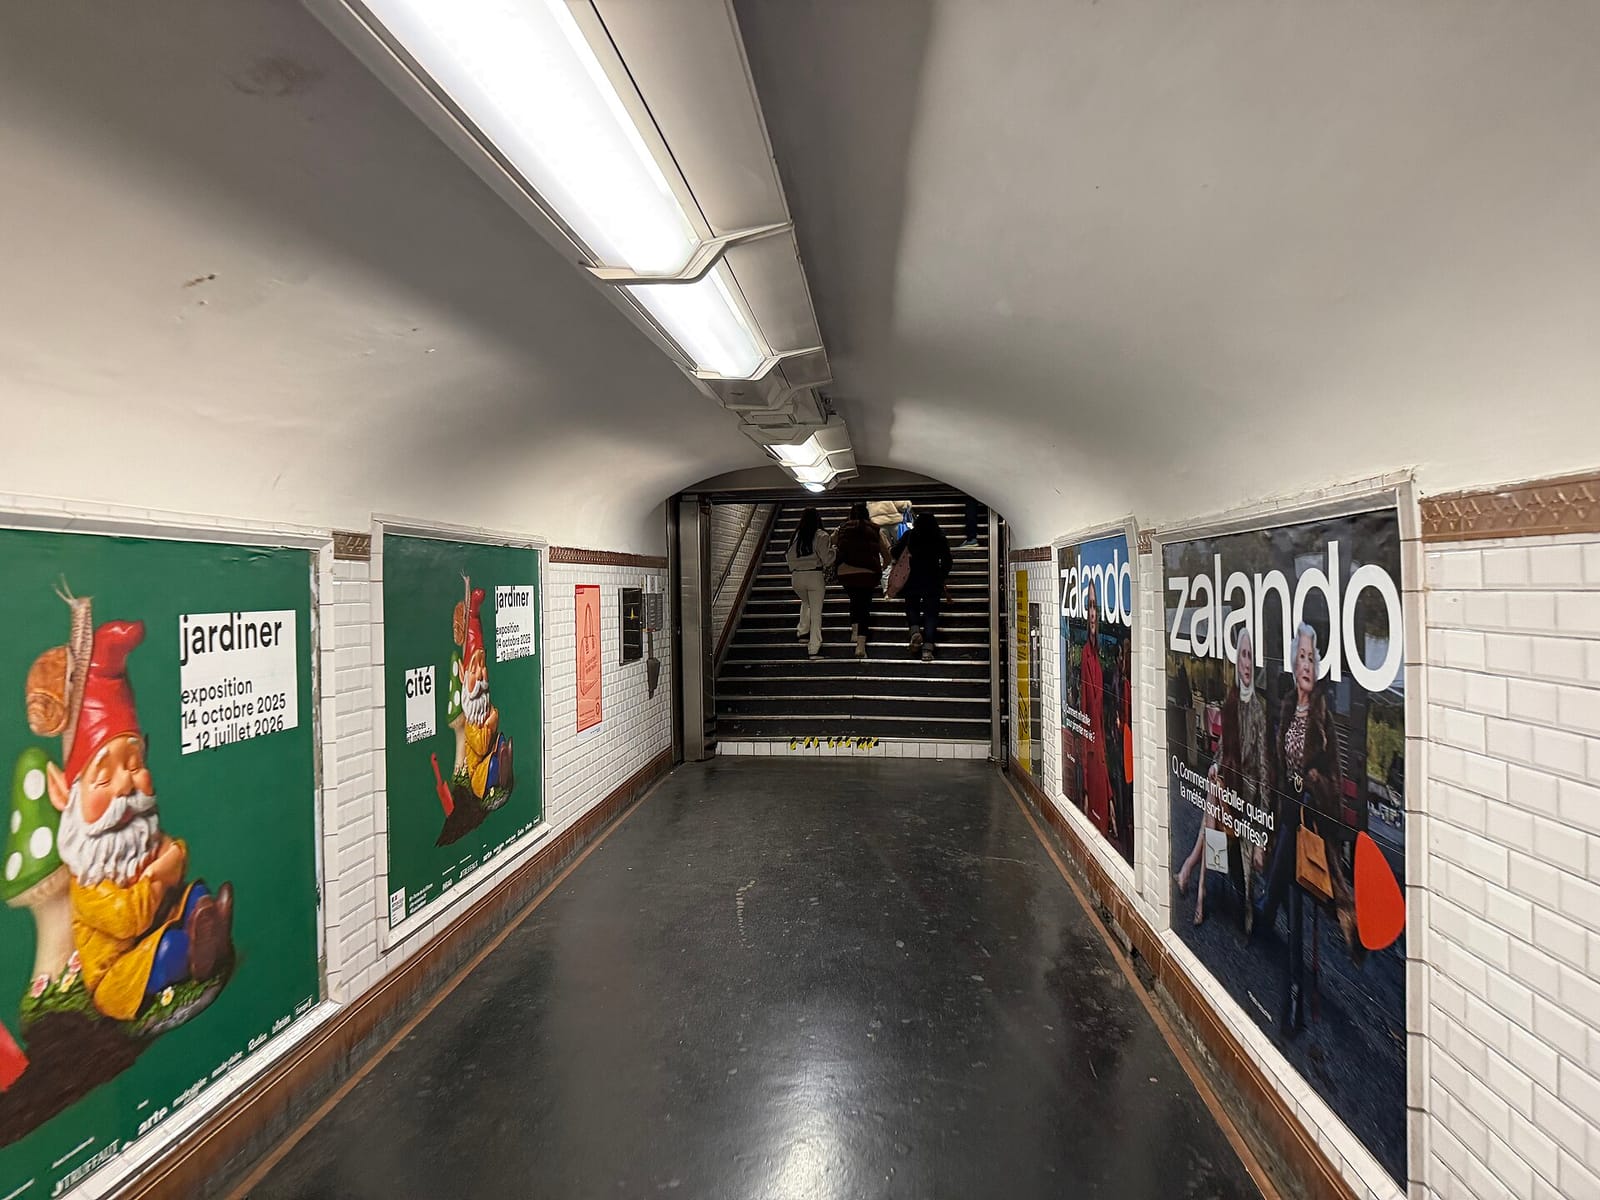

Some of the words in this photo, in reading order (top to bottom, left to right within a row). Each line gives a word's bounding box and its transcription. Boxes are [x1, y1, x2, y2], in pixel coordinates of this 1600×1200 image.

[496, 585, 529, 614] jardiner
[1061, 549, 1132, 627] zalando
[496, 622, 520, 637] exposition
[1168, 540, 1403, 692] zalando
[180, 612, 282, 666] jardiner
[502, 635, 520, 648] octobre
[181, 677, 253, 707] exposition
[406, 666, 432, 698] cité
[181, 709, 197, 729] 14
[201, 700, 254, 725] octobre
[257, 693, 286, 714] 2025
[196, 730, 210, 750] 12
[214, 722, 251, 751] juillet
[254, 714, 284, 736] 2026
[1180, 761, 1210, 793] Comment
[1246, 802, 1274, 831] quand
[1180, 780, 1185, 798] la
[1186, 788, 1206, 812] météo
[1206, 801, 1221, 822] sort
[1221, 807, 1233, 829] les
[1233, 818, 1261, 847] griffes
